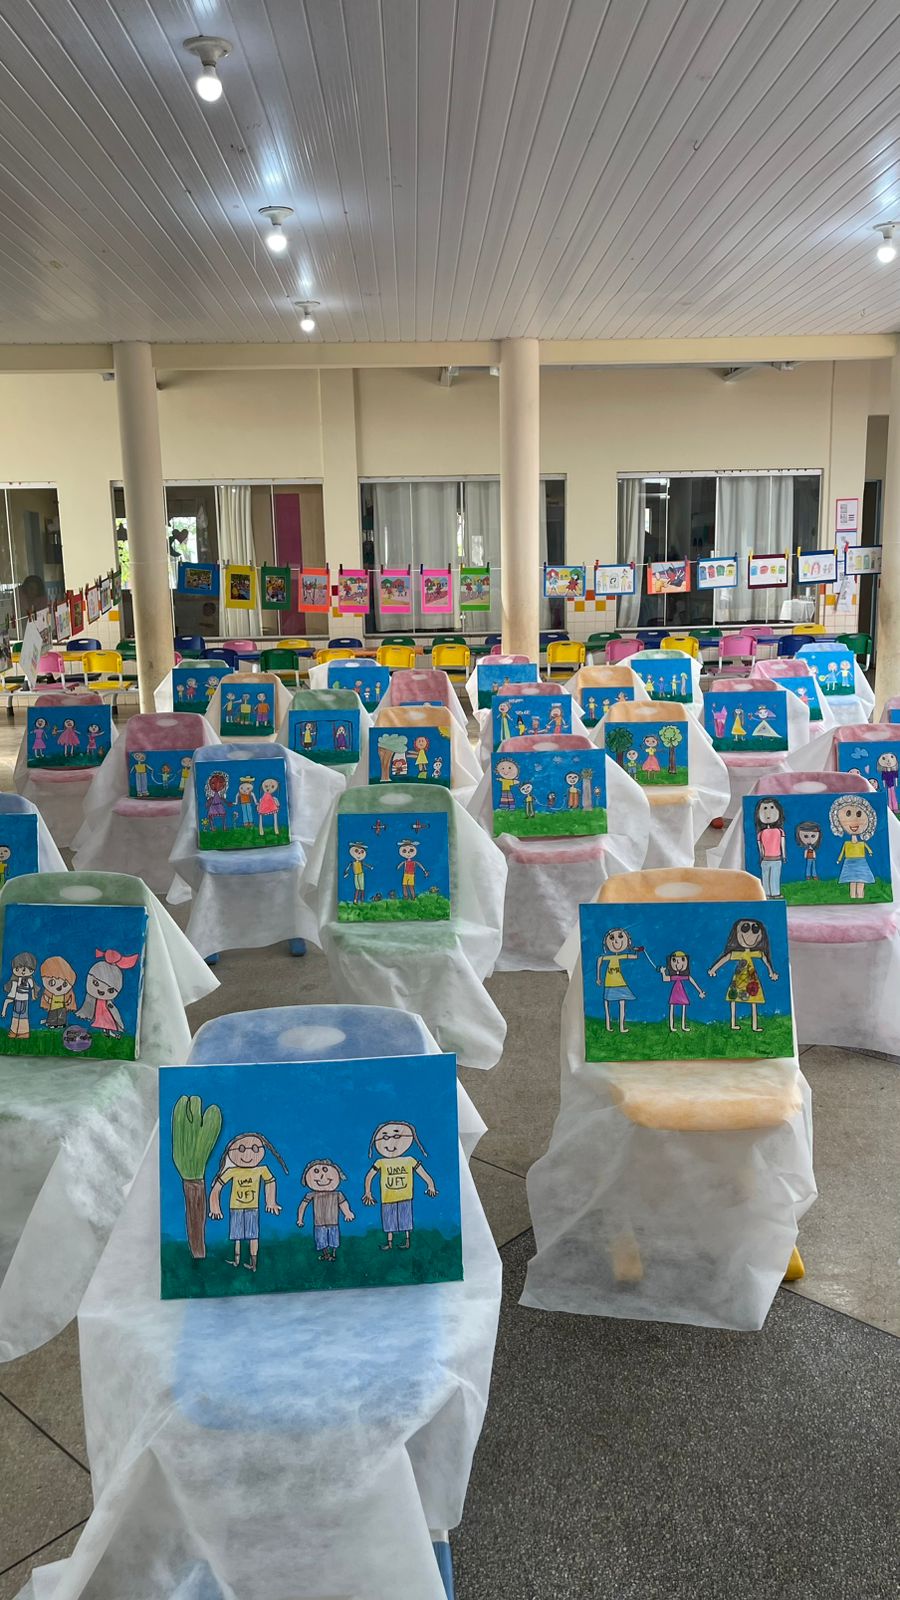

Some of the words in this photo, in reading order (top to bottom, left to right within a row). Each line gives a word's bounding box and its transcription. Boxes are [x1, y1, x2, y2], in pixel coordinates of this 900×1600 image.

[386, 1165, 407, 1175] UMA
[387, 1176, 406, 1187] UFT
[236, 1189, 256, 1199] UFT
